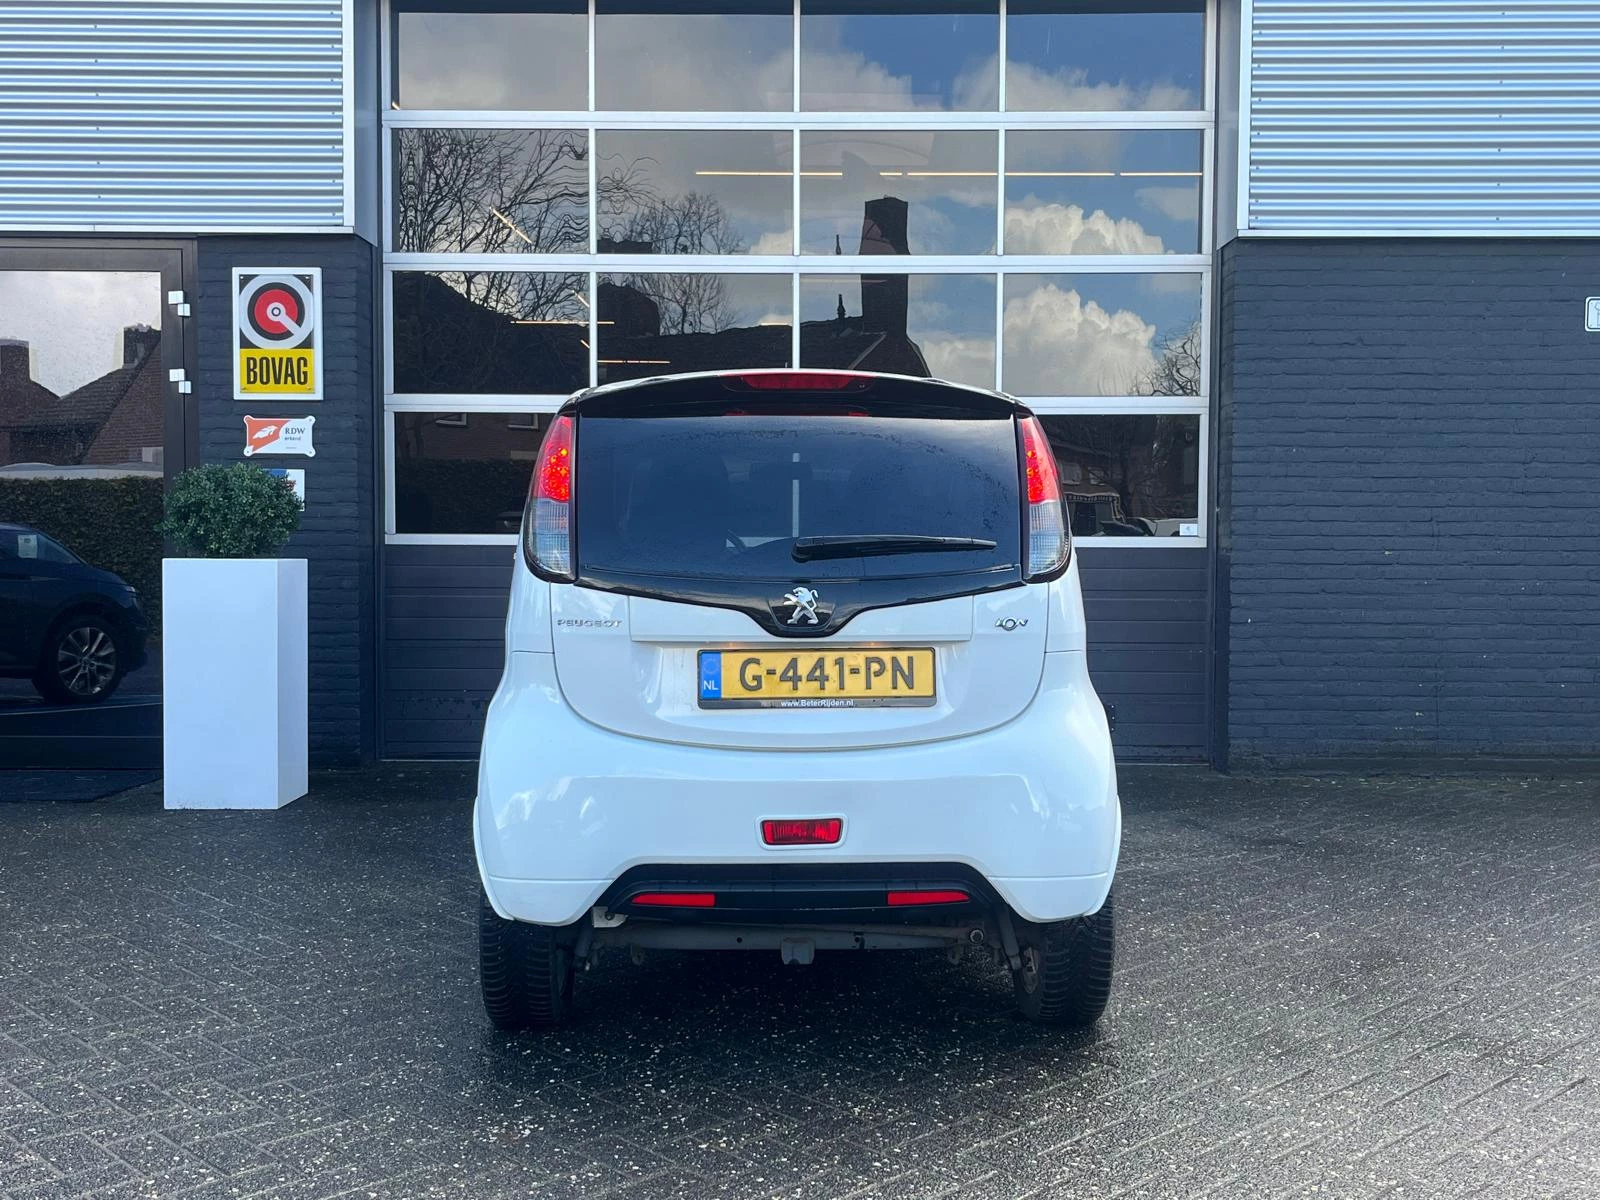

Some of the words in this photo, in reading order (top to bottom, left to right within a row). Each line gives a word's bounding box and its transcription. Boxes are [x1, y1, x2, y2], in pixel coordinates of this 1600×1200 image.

[246, 356, 308, 385] BOVAG
[285, 427, 306, 435] RDW
[556, 619, 623, 628] PEUGEOT
[739, 656, 914, 691] G-441-PN
[703, 680, 718, 690] NL
[780, 698, 854, 707] www.BeterRijden.nl
